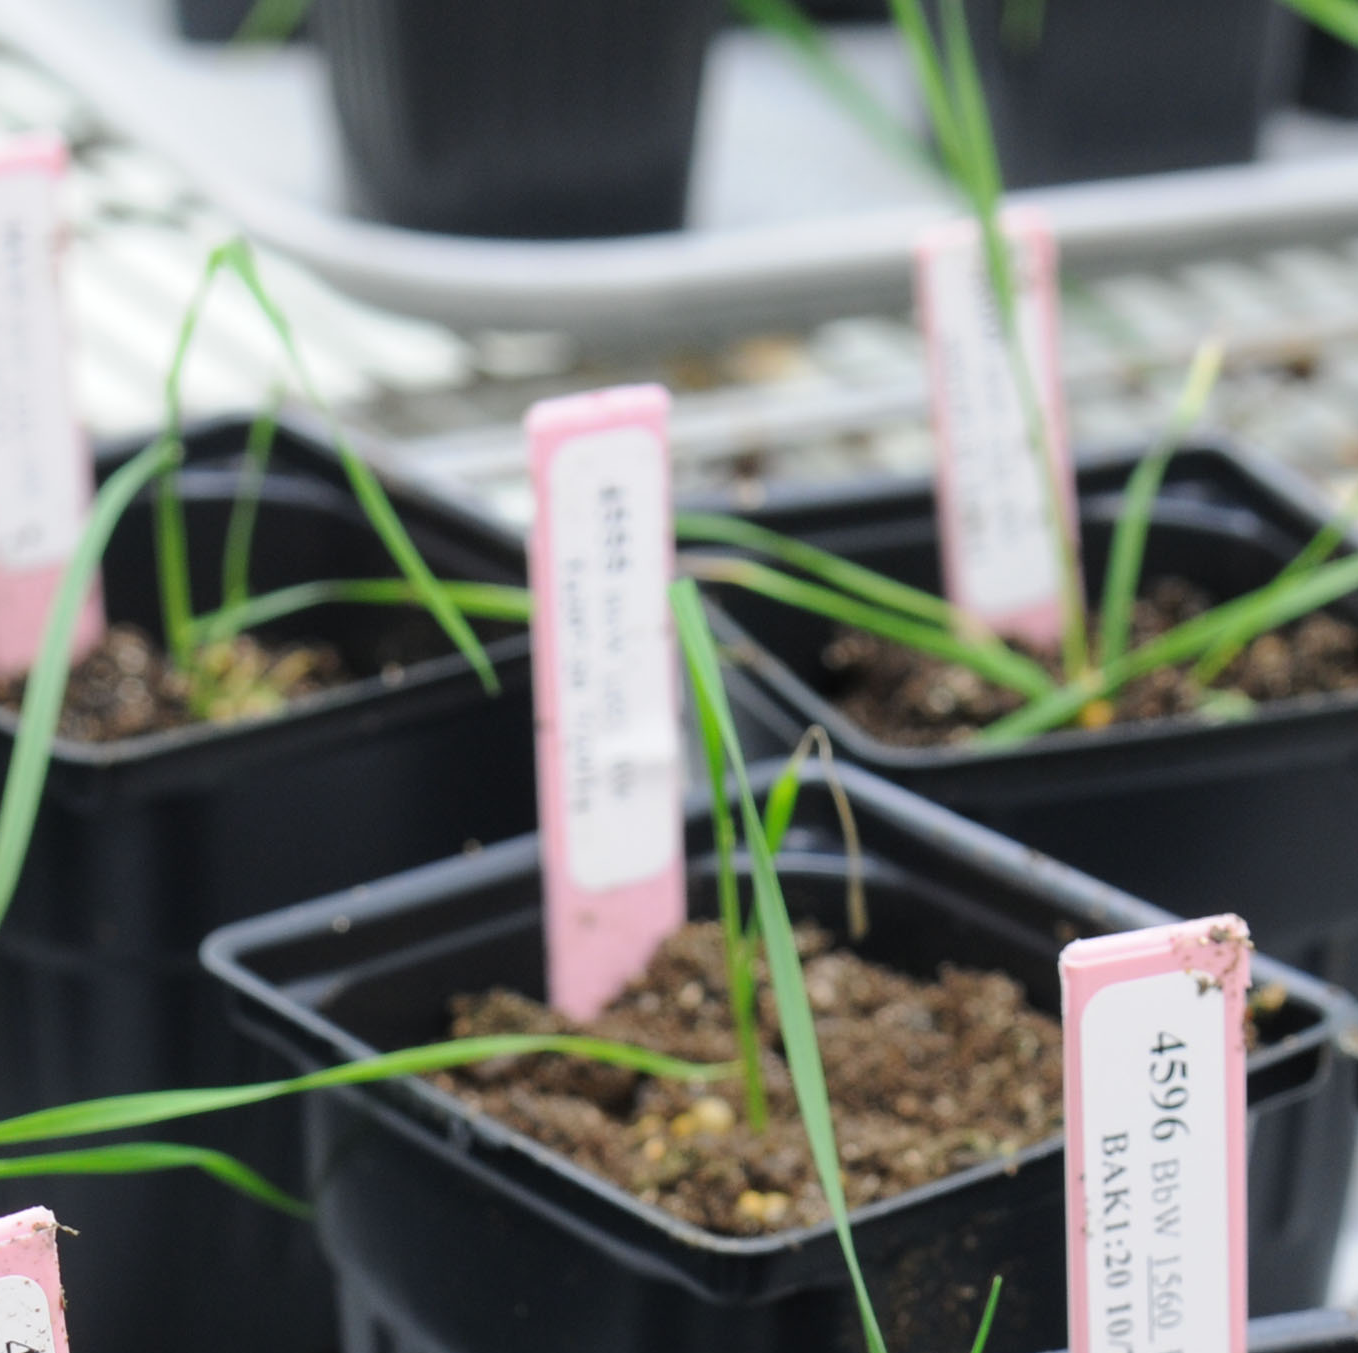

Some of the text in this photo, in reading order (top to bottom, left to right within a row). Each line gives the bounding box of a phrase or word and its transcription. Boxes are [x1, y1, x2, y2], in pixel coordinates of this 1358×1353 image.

[1149, 1031, 1191, 1143] 4596
[1101, 1131, 1133, 1291] BAK1:20
[1151, 1158, 1182, 1240] BbW
[1148, 1255, 1183, 1342] 1560
